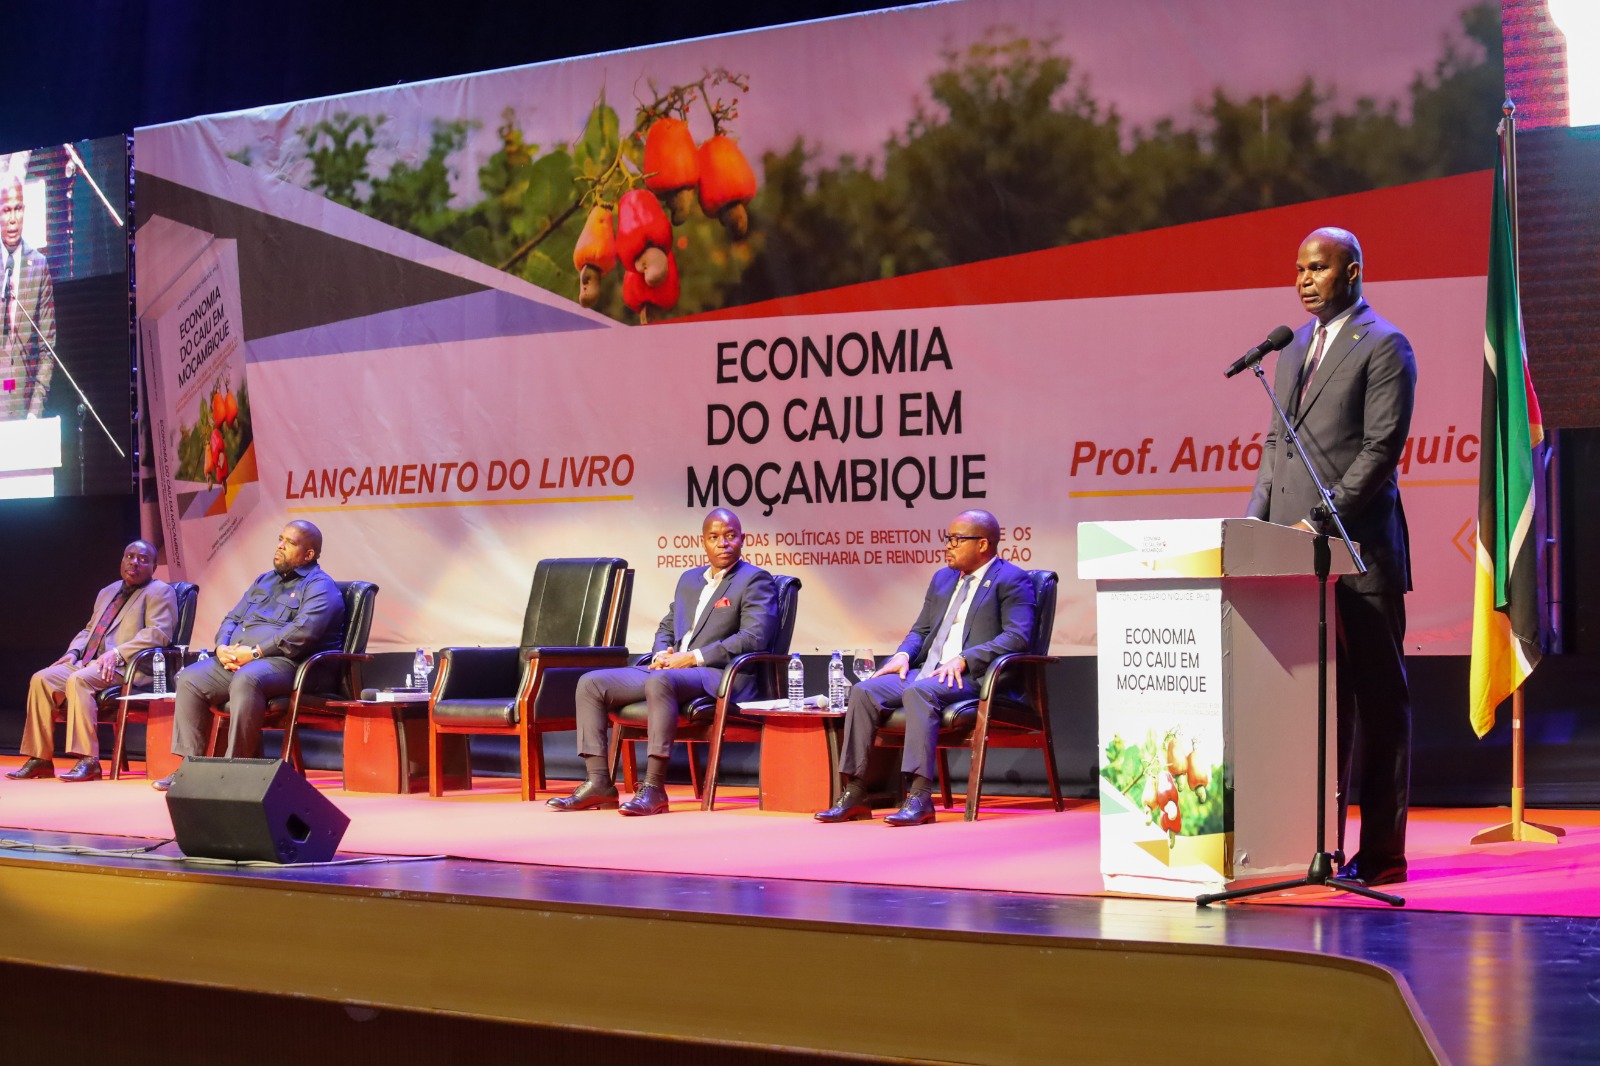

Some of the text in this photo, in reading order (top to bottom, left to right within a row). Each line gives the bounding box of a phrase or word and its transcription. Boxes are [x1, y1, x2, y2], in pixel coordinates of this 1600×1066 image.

[180, 285, 221, 340] ECONOMIA
[180, 303, 224, 363] DO CAJU EM
[178, 320, 230, 389] MOÇAMBIQUE
[716, 326, 953, 384] ECONOMIA
[707, 390, 963, 446] DO CAJU EM
[1069, 425, 1480, 477] Prof. Antó quic
[286, 454, 635, 504] LANÇAMENTO DO LIVRO
[687, 454, 987, 517] MOÇAMBIQUE
[657, 536, 668, 549] O
[745, 533, 769, 547] DAS
[775, 529, 840, 546] POLÍTICAS
[846, 530, 864, 545] DE
[870, 529, 931, 544] BRETTON
[1013, 526, 1031, 541] OS
[754, 552, 773, 566] DA
[775, 551, 861, 566] ENGENHARIA
[864, 550, 883, 564] DE
[1123, 651, 1200, 669] DO CAJU EM
[1125, 628, 1197, 646] ECONOMIA
[1117, 674, 1207, 694] MOÇAMBIQUE
